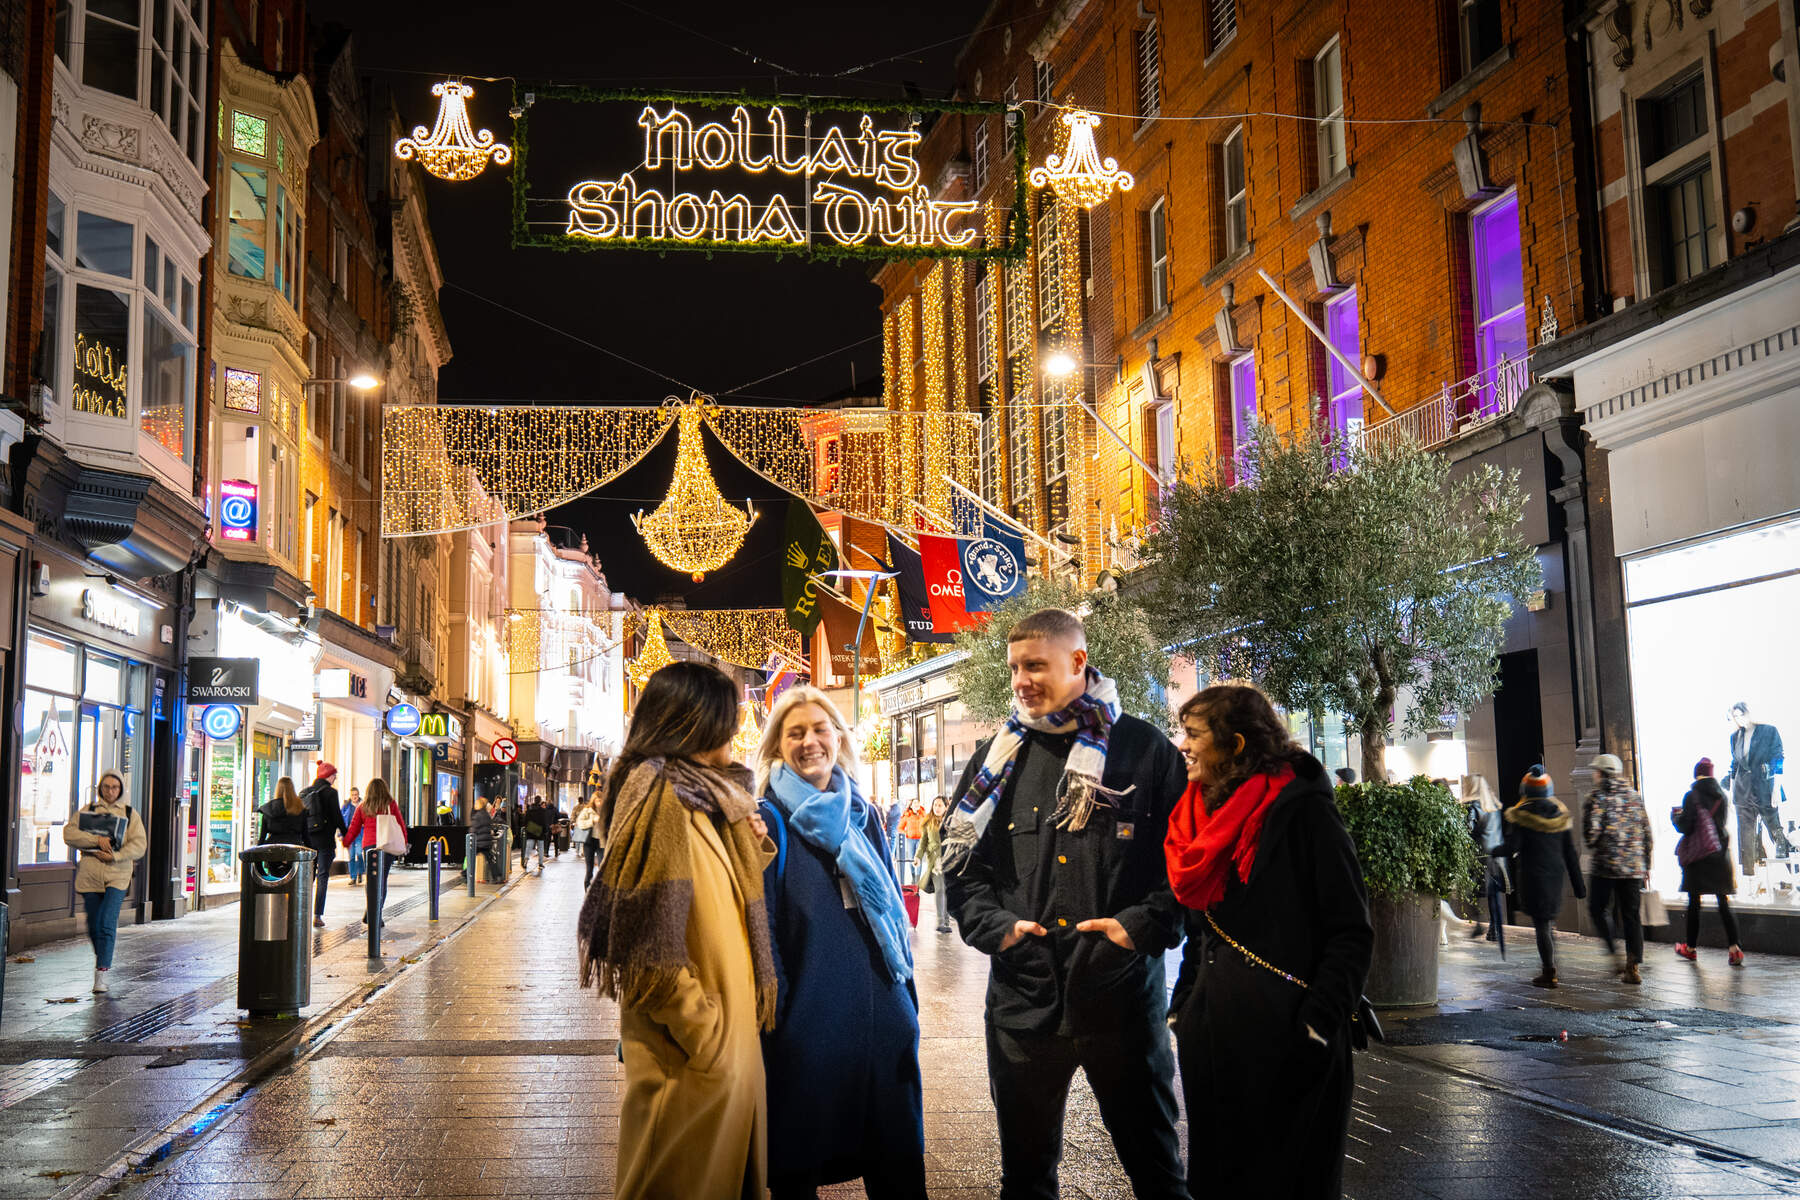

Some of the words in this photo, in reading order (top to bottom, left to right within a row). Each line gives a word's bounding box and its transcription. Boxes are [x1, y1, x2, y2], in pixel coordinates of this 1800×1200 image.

[566, 173, 806, 242] Shona
[930, 583, 966, 598] OME
[908, 620, 934, 631] TUD
[191, 686, 251, 697] SWAROVSKI
